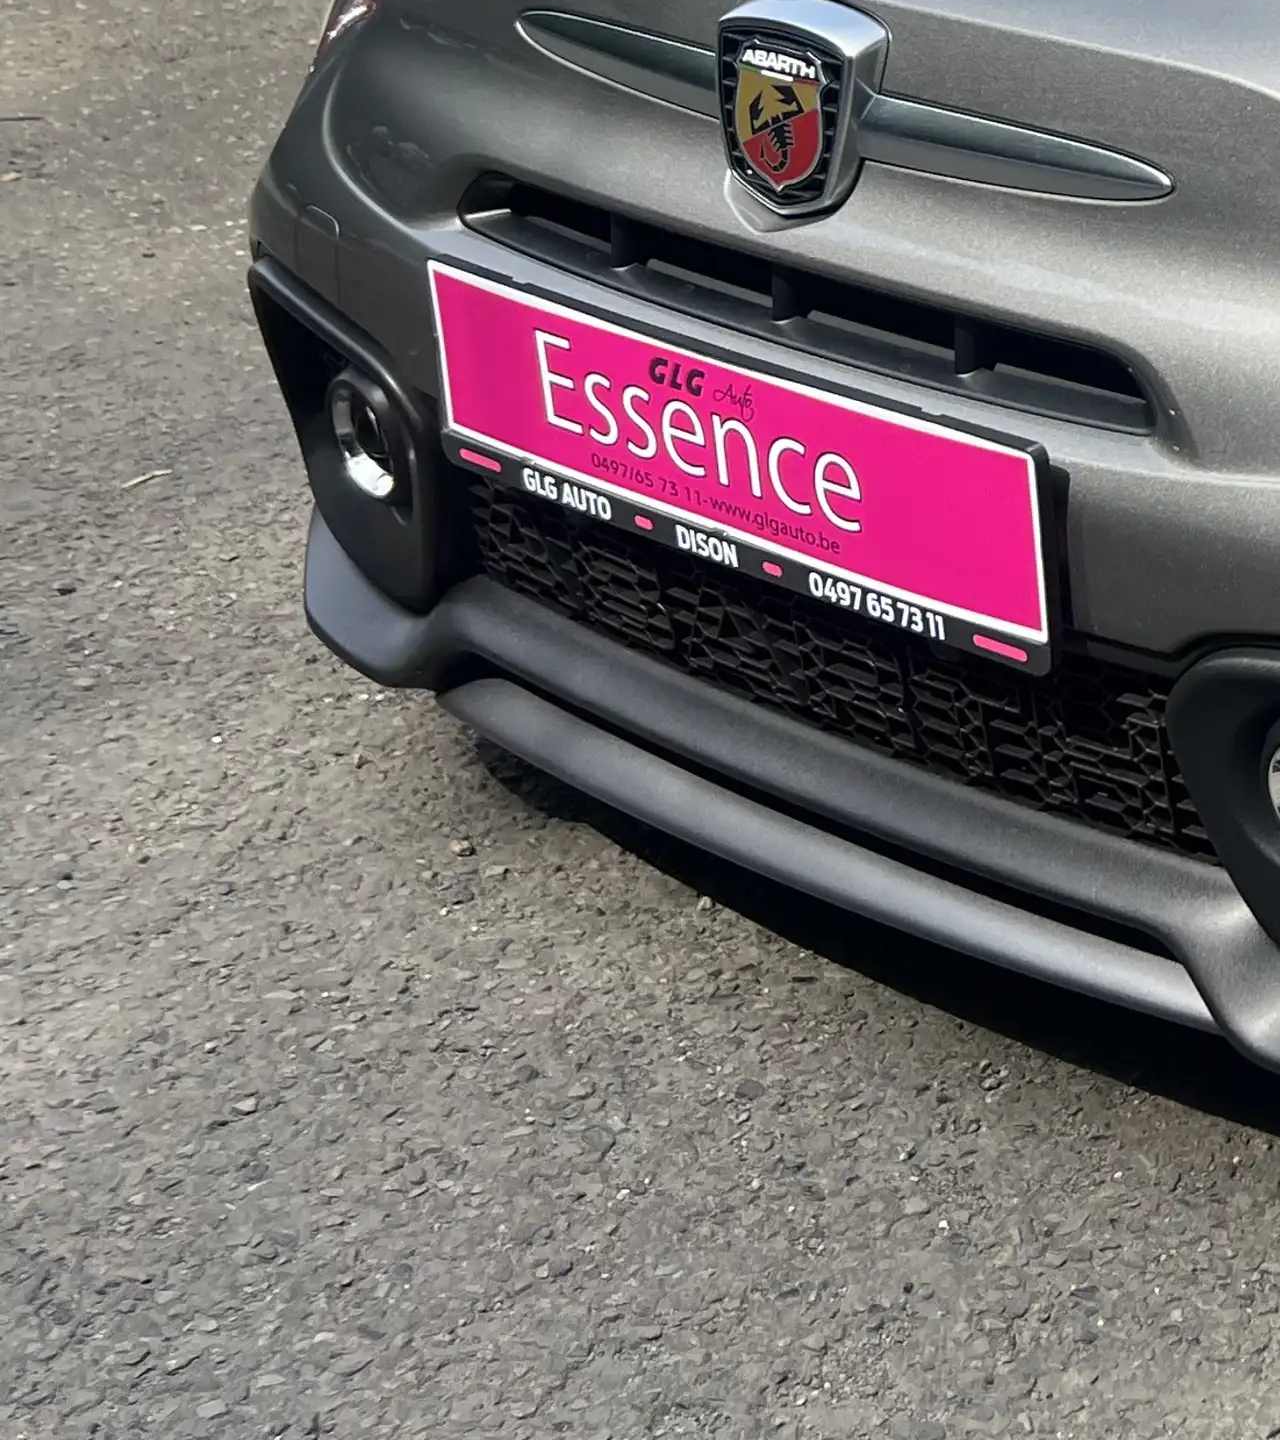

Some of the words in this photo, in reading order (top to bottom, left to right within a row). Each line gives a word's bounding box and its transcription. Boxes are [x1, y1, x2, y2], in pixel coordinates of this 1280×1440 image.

[742, 48, 815, 79] ABARTH
[648, 356, 706, 398] GLG
[712, 383, 755, 422] Auto
[533, 328, 863, 533] Essence
[657, 476, 679, 497] 73
[522, 467, 558, 500] GLG
[561, 481, 612, 521] AUTO
[675, 523, 740, 568] DISON
[808, 571, 863, 611] 0497
[866, 592, 895, 622] 65
[896, 601, 924, 633] 73
[925, 611, 946, 641] 11
